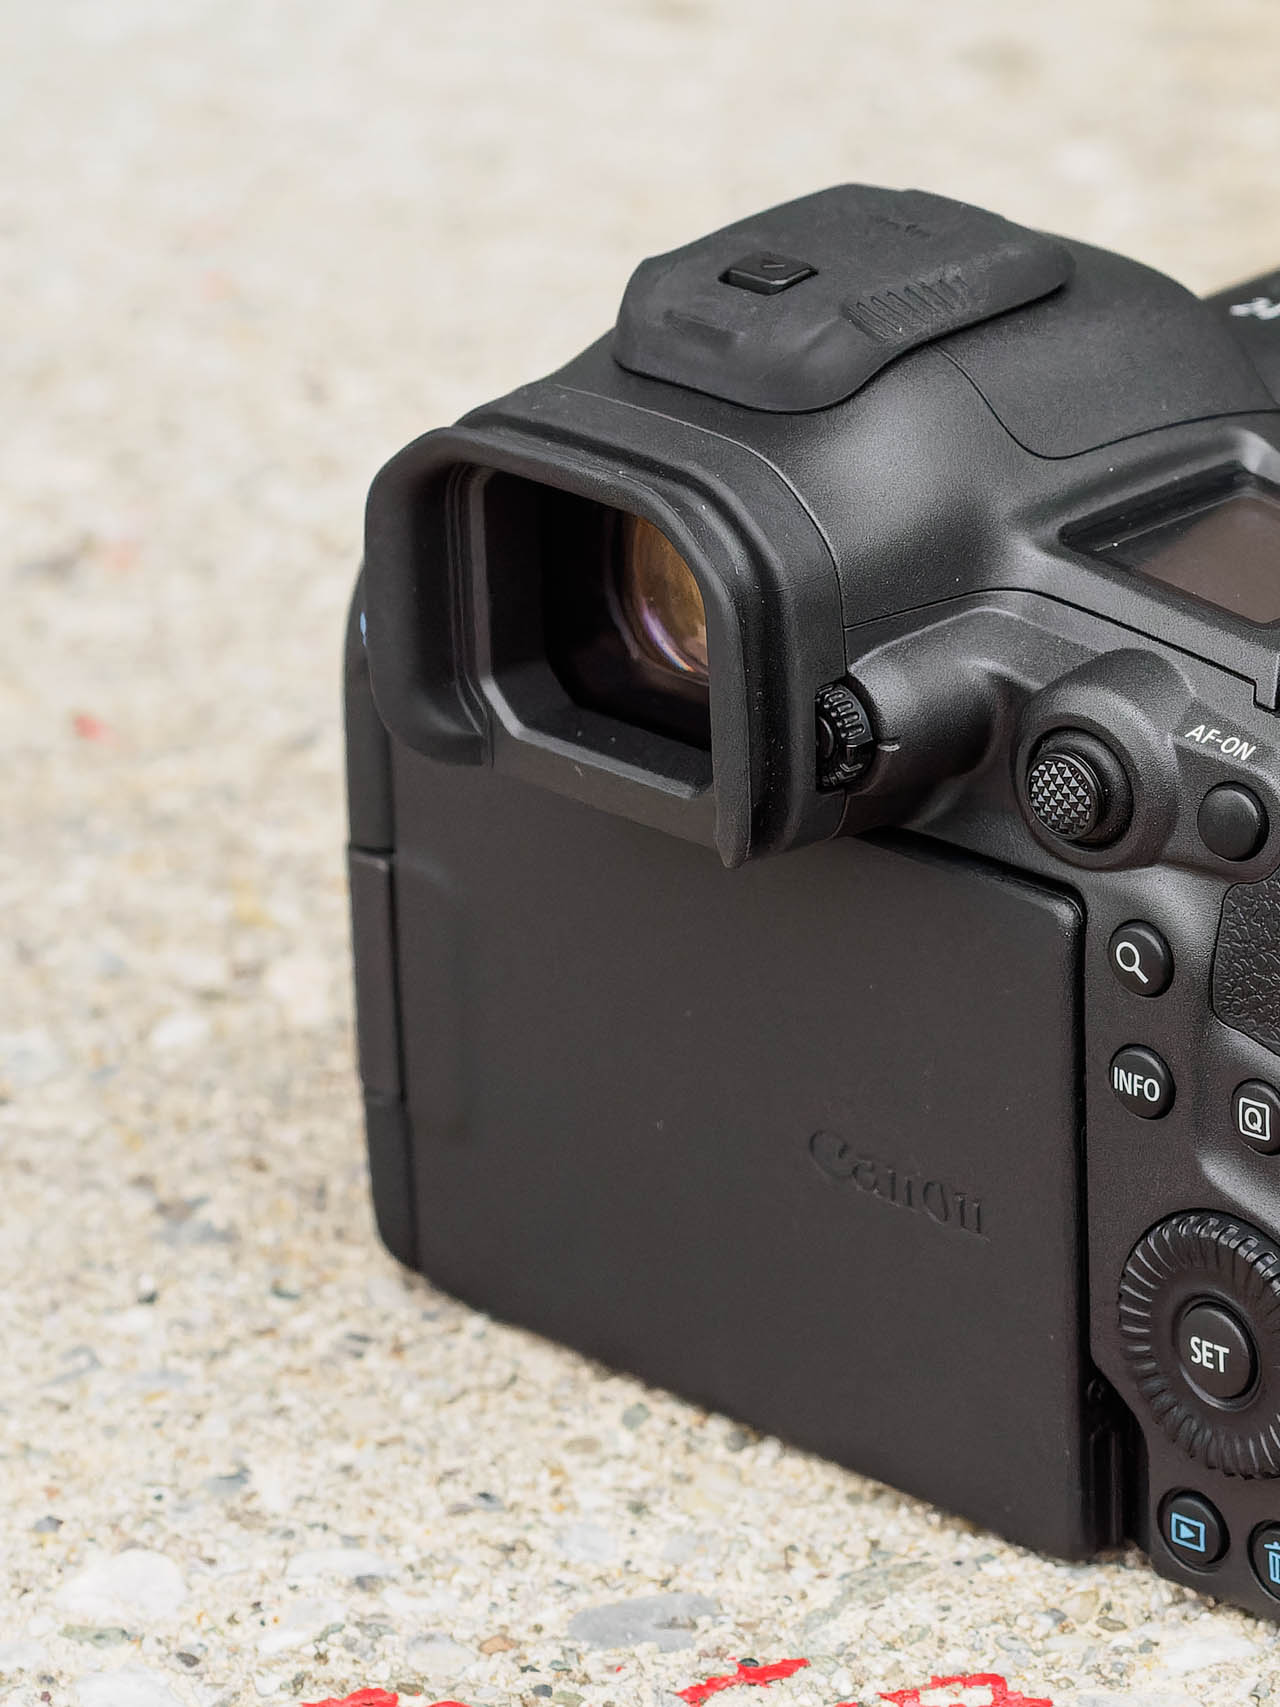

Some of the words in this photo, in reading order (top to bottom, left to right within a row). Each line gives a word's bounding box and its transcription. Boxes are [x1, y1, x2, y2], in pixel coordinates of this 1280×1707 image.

[1185, 724, 1257, 761] AF-ON
[1113, 1066, 1160, 1102] INFO
[1244, 1108, 1263, 1133] Q
[1190, 1336, 1230, 1373] SET
